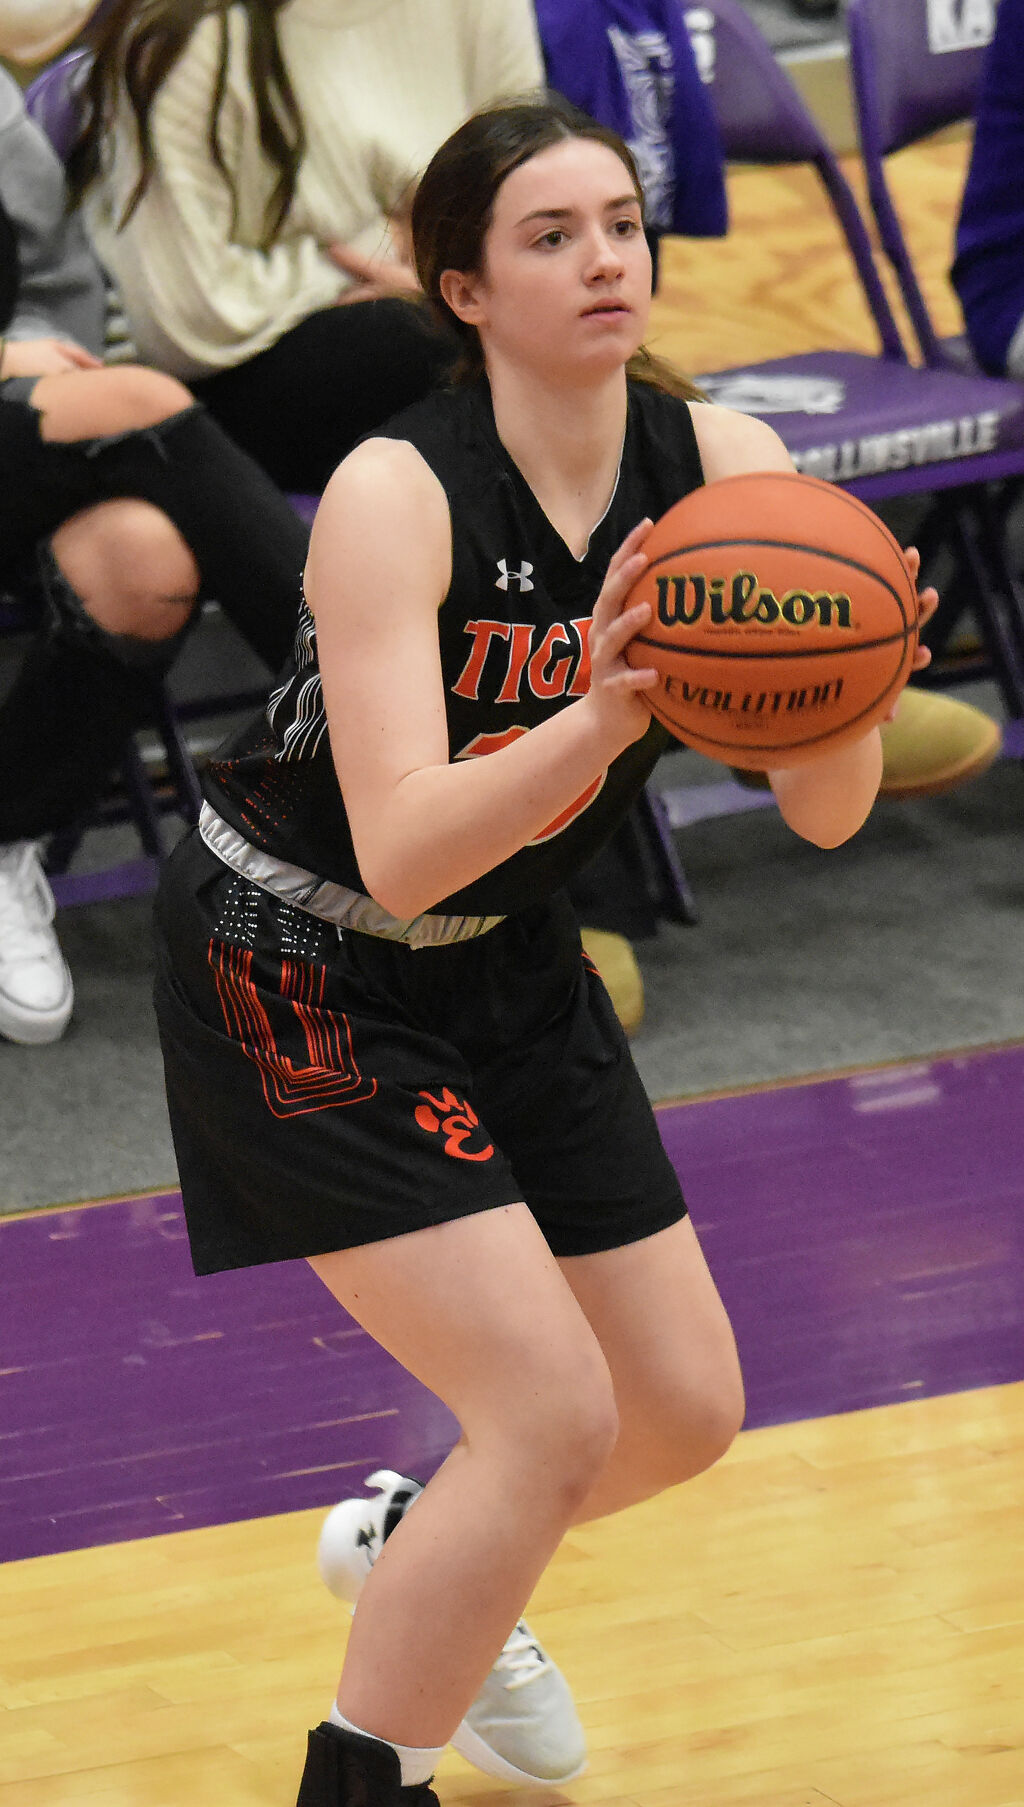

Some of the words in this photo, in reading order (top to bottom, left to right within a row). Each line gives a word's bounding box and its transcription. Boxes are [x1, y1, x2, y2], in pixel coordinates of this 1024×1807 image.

[791, 411, 999, 481] OLLINSVILLE
[656, 567, 852, 629] Wilson
[664, 674, 844, 714] EVOLUTION
